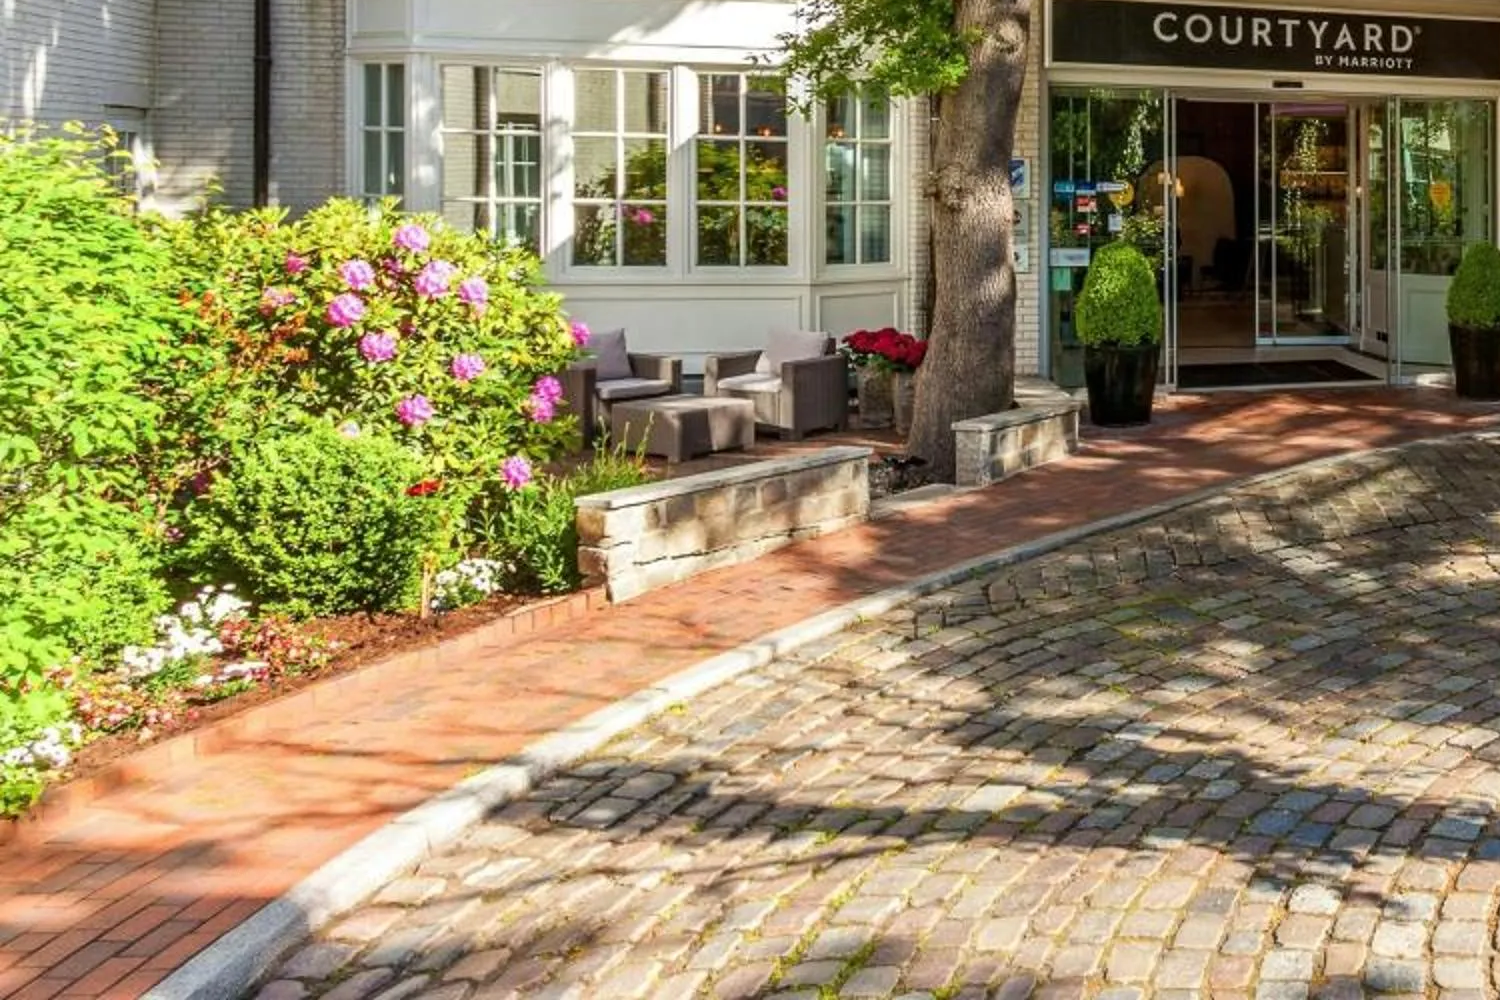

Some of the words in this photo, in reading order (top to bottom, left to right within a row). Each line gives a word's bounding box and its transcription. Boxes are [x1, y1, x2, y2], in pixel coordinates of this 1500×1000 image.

[1153, 12, 1413, 53] COURTYARD
[1315, 55, 1333, 65] BY
[1339, 56, 1412, 69] MARRIOTT
